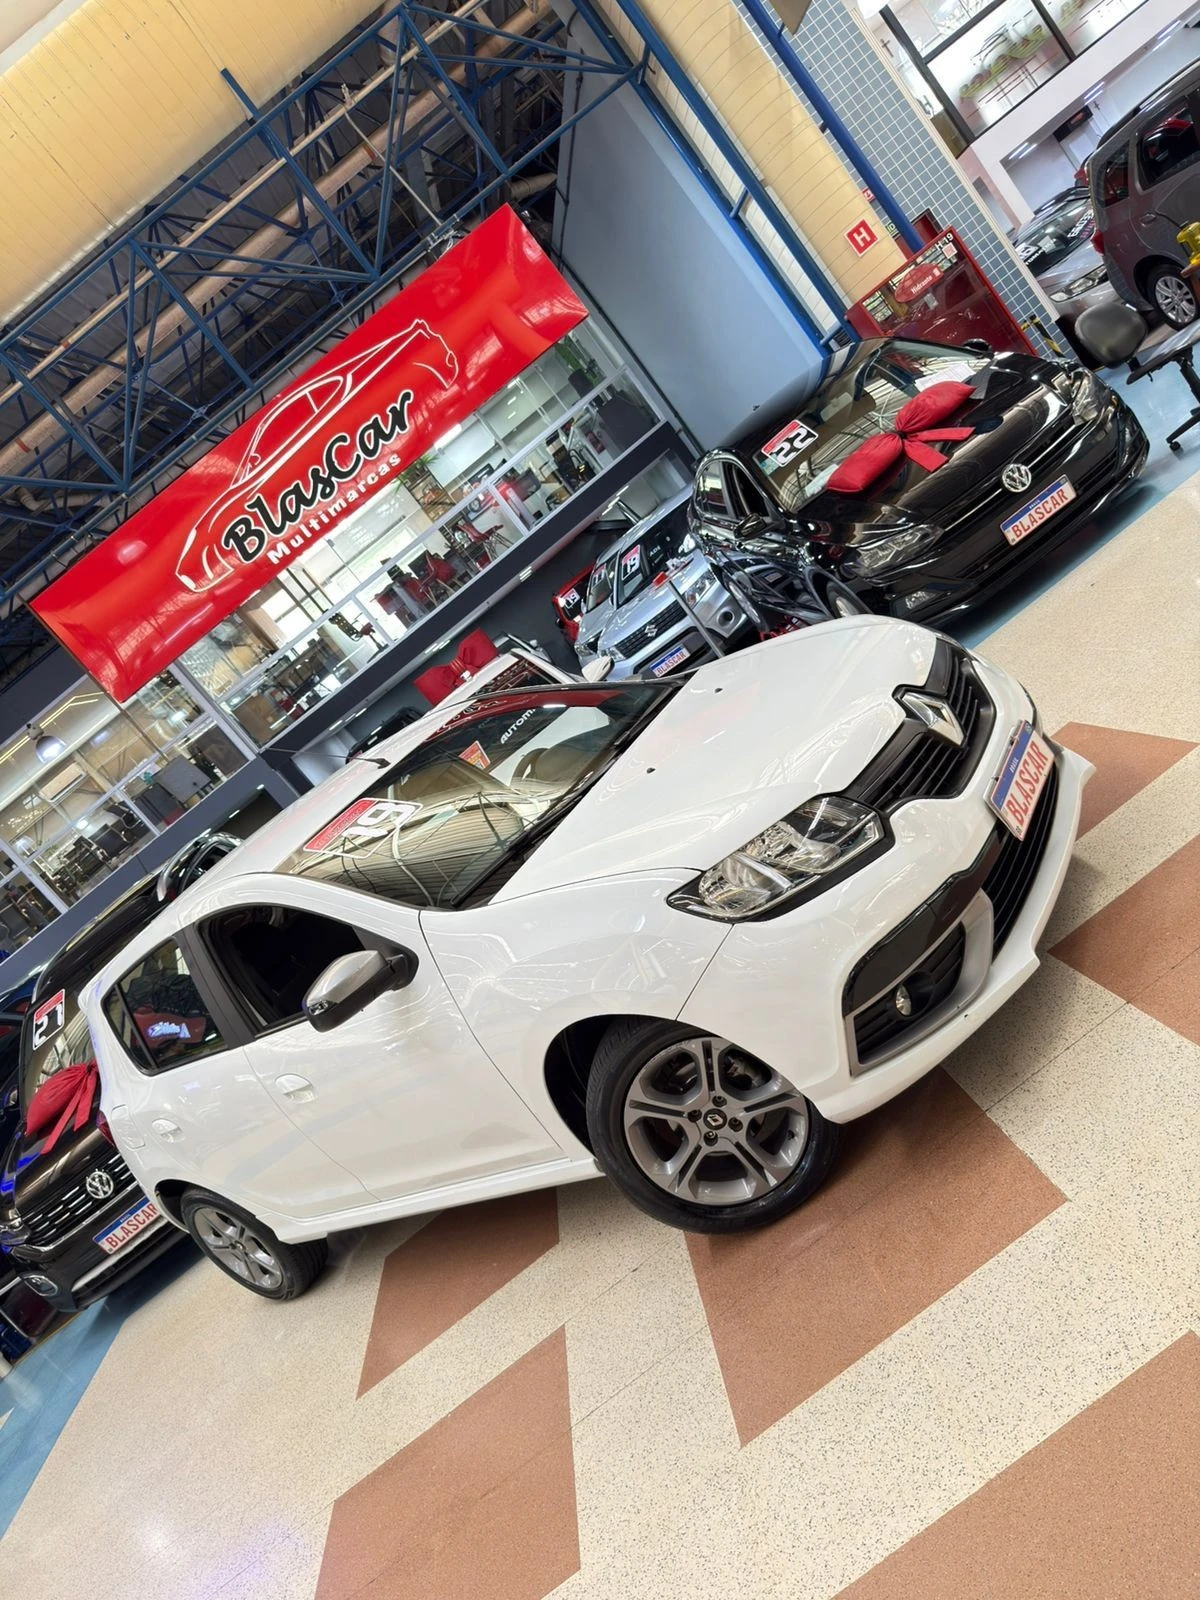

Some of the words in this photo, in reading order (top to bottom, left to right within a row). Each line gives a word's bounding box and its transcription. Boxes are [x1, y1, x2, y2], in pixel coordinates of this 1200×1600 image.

[853, 227, 871, 248] H
[910, 275, 933, 294] Hidrante
[772, 427, 814, 464] 22
[222, 390, 413, 563] BlasCar
[266, 453, 402, 565] Multimarcas
[1011, 488, 1069, 538] BLASCAR
[656, 651, 687, 675] BLASCAR
[1005, 740, 1049, 828] BLASCAR
[341, 802, 416, 838] 19
[34, 1003, 63, 1046] 21
[105, 1203, 158, 1248] BLASCAR
